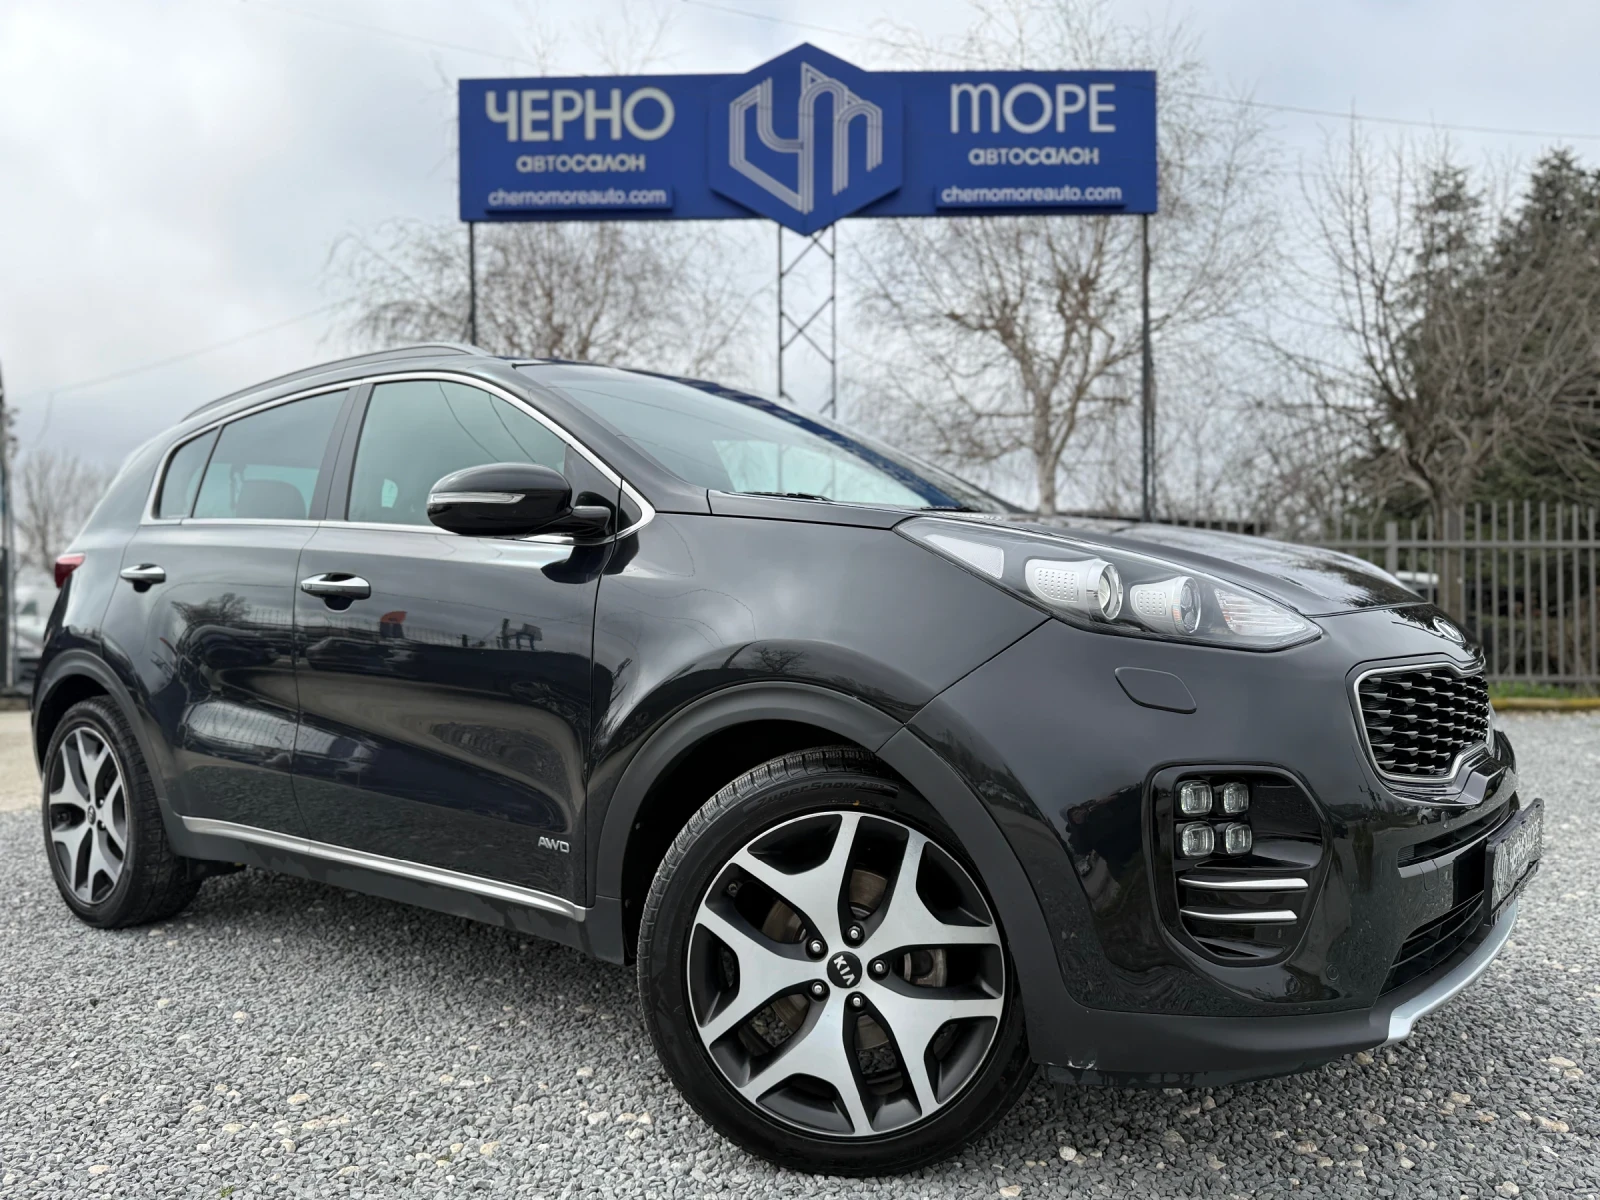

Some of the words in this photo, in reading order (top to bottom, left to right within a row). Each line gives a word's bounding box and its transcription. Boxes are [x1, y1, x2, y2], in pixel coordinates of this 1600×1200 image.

[485, 86, 675, 142] ЧЕРНО
[950, 82, 1116, 134] МОРЕ
[488, 187, 667, 207] chernomoreauto.com
[941, 185, 1122, 204] chernomoreauto.com
[537, 836, 570, 853] AWD
[833, 955, 856, 986] KIA
